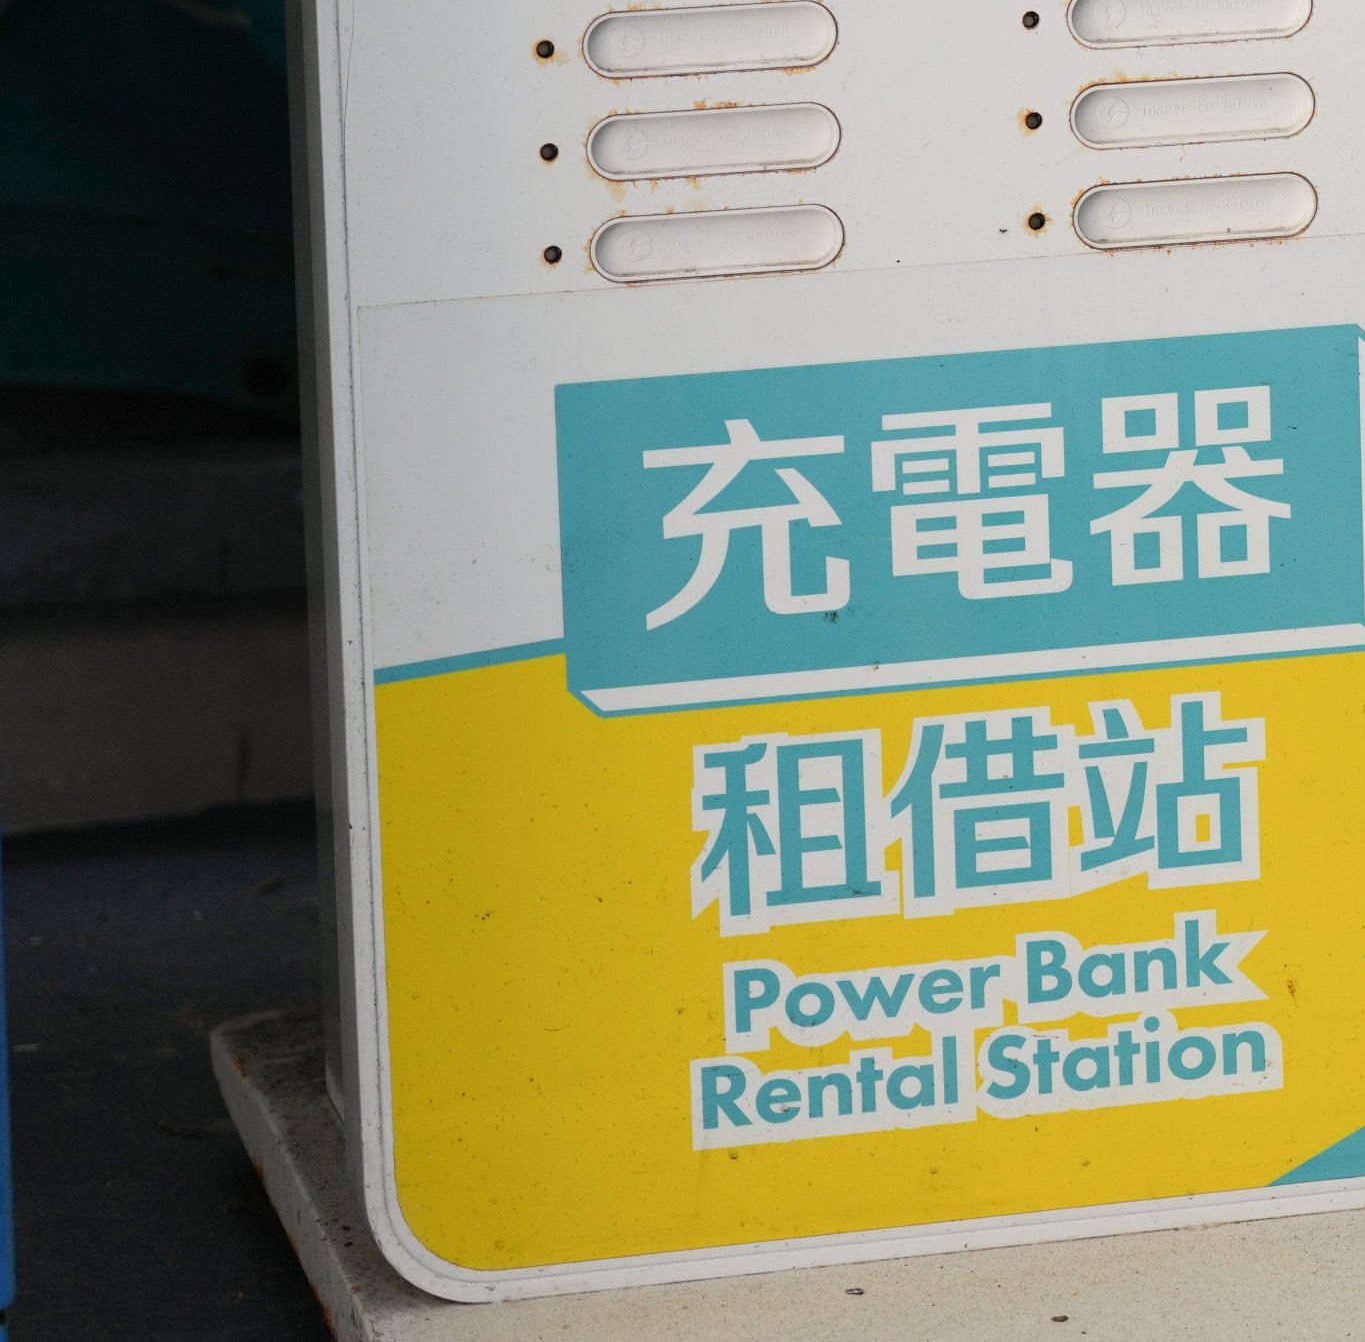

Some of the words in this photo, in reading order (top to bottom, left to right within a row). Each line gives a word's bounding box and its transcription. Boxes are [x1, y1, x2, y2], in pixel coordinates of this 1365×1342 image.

[1216, 0, 1263, 10] Return
[1218, 99, 1266, 110] Return
[1222, 199, 1269, 210] Return
[641, 384, 1292, 632] 充電器
[699, 700, 1250, 918] 租借站
[733, 962, 1002, 1034] Power
[1025, 918, 1234, 1005] Bank
[700, 1035, 959, 1131] Rental
[986, 1015, 1266, 1101] Station
